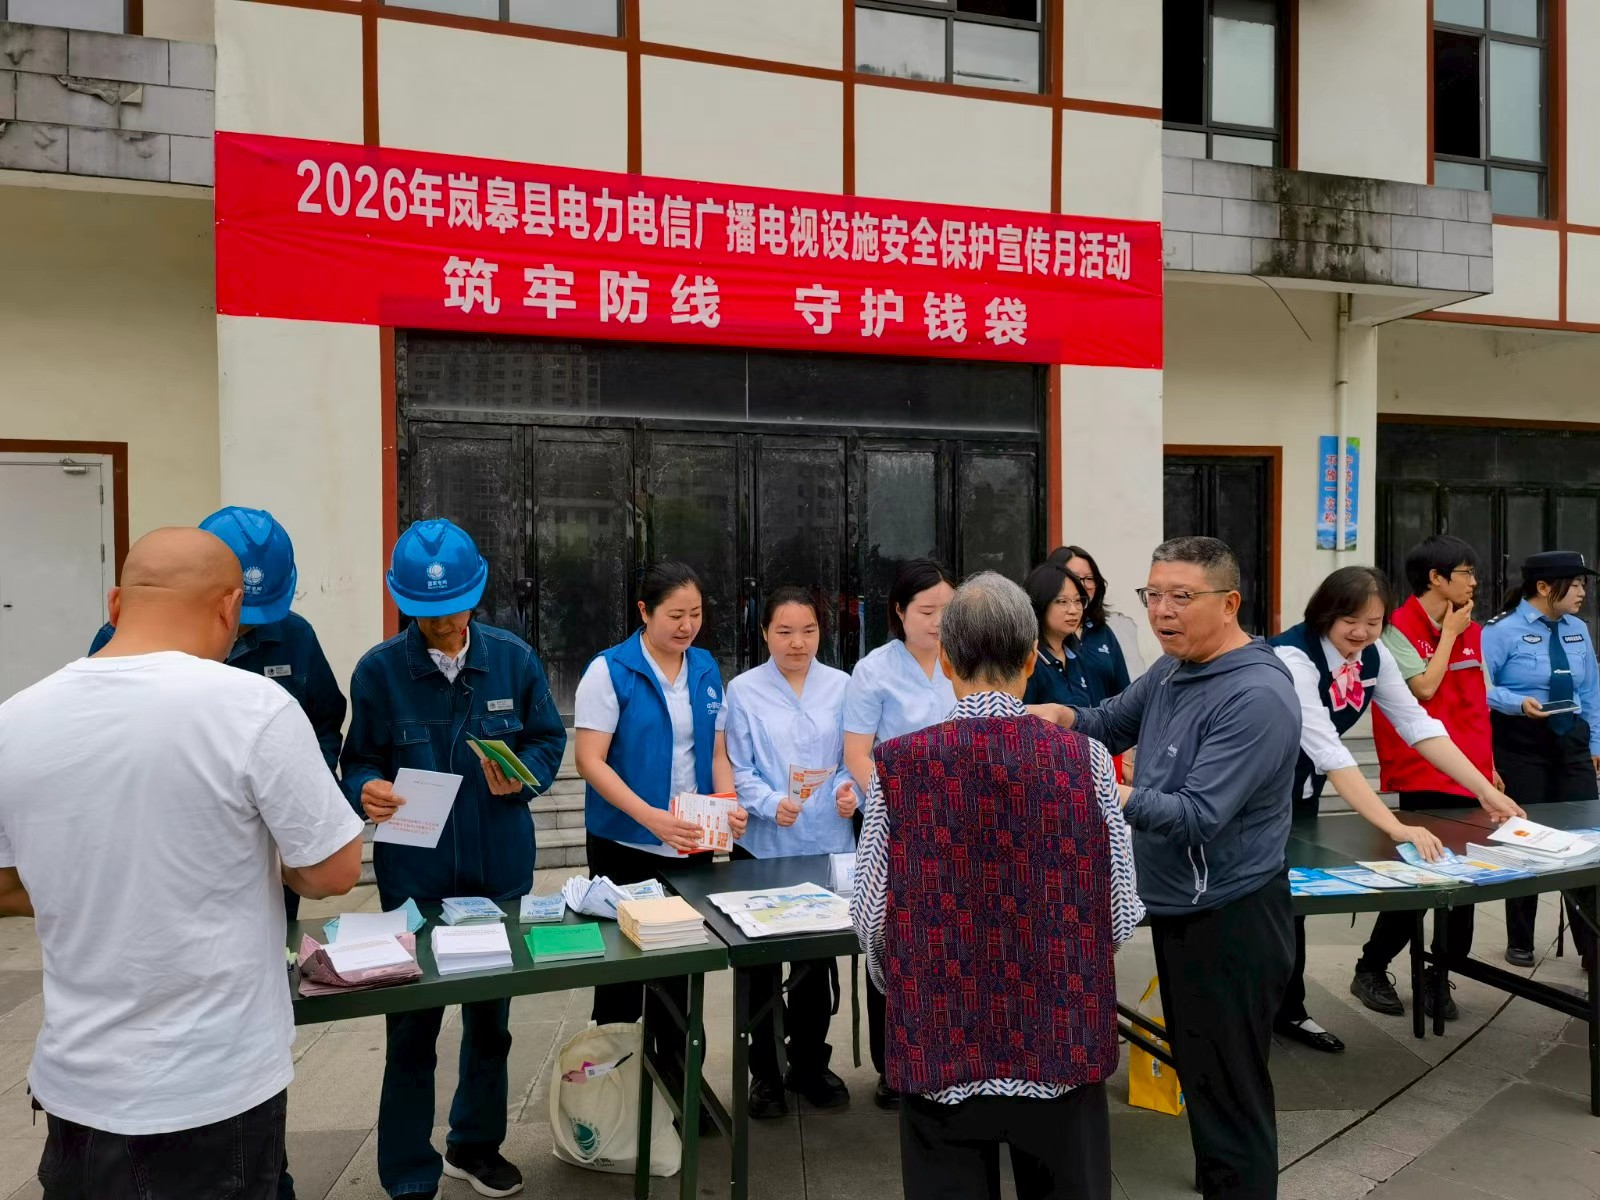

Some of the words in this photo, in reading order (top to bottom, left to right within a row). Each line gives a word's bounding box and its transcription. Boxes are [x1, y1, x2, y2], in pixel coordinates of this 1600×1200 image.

[296, 159, 1131, 281] 2026年岚皋县电力电信广播电视设施安全保护宣传月活动
[443, 255, 720, 329] 筑牢防线
[794, 283, 1028, 346] 守护钱袋
